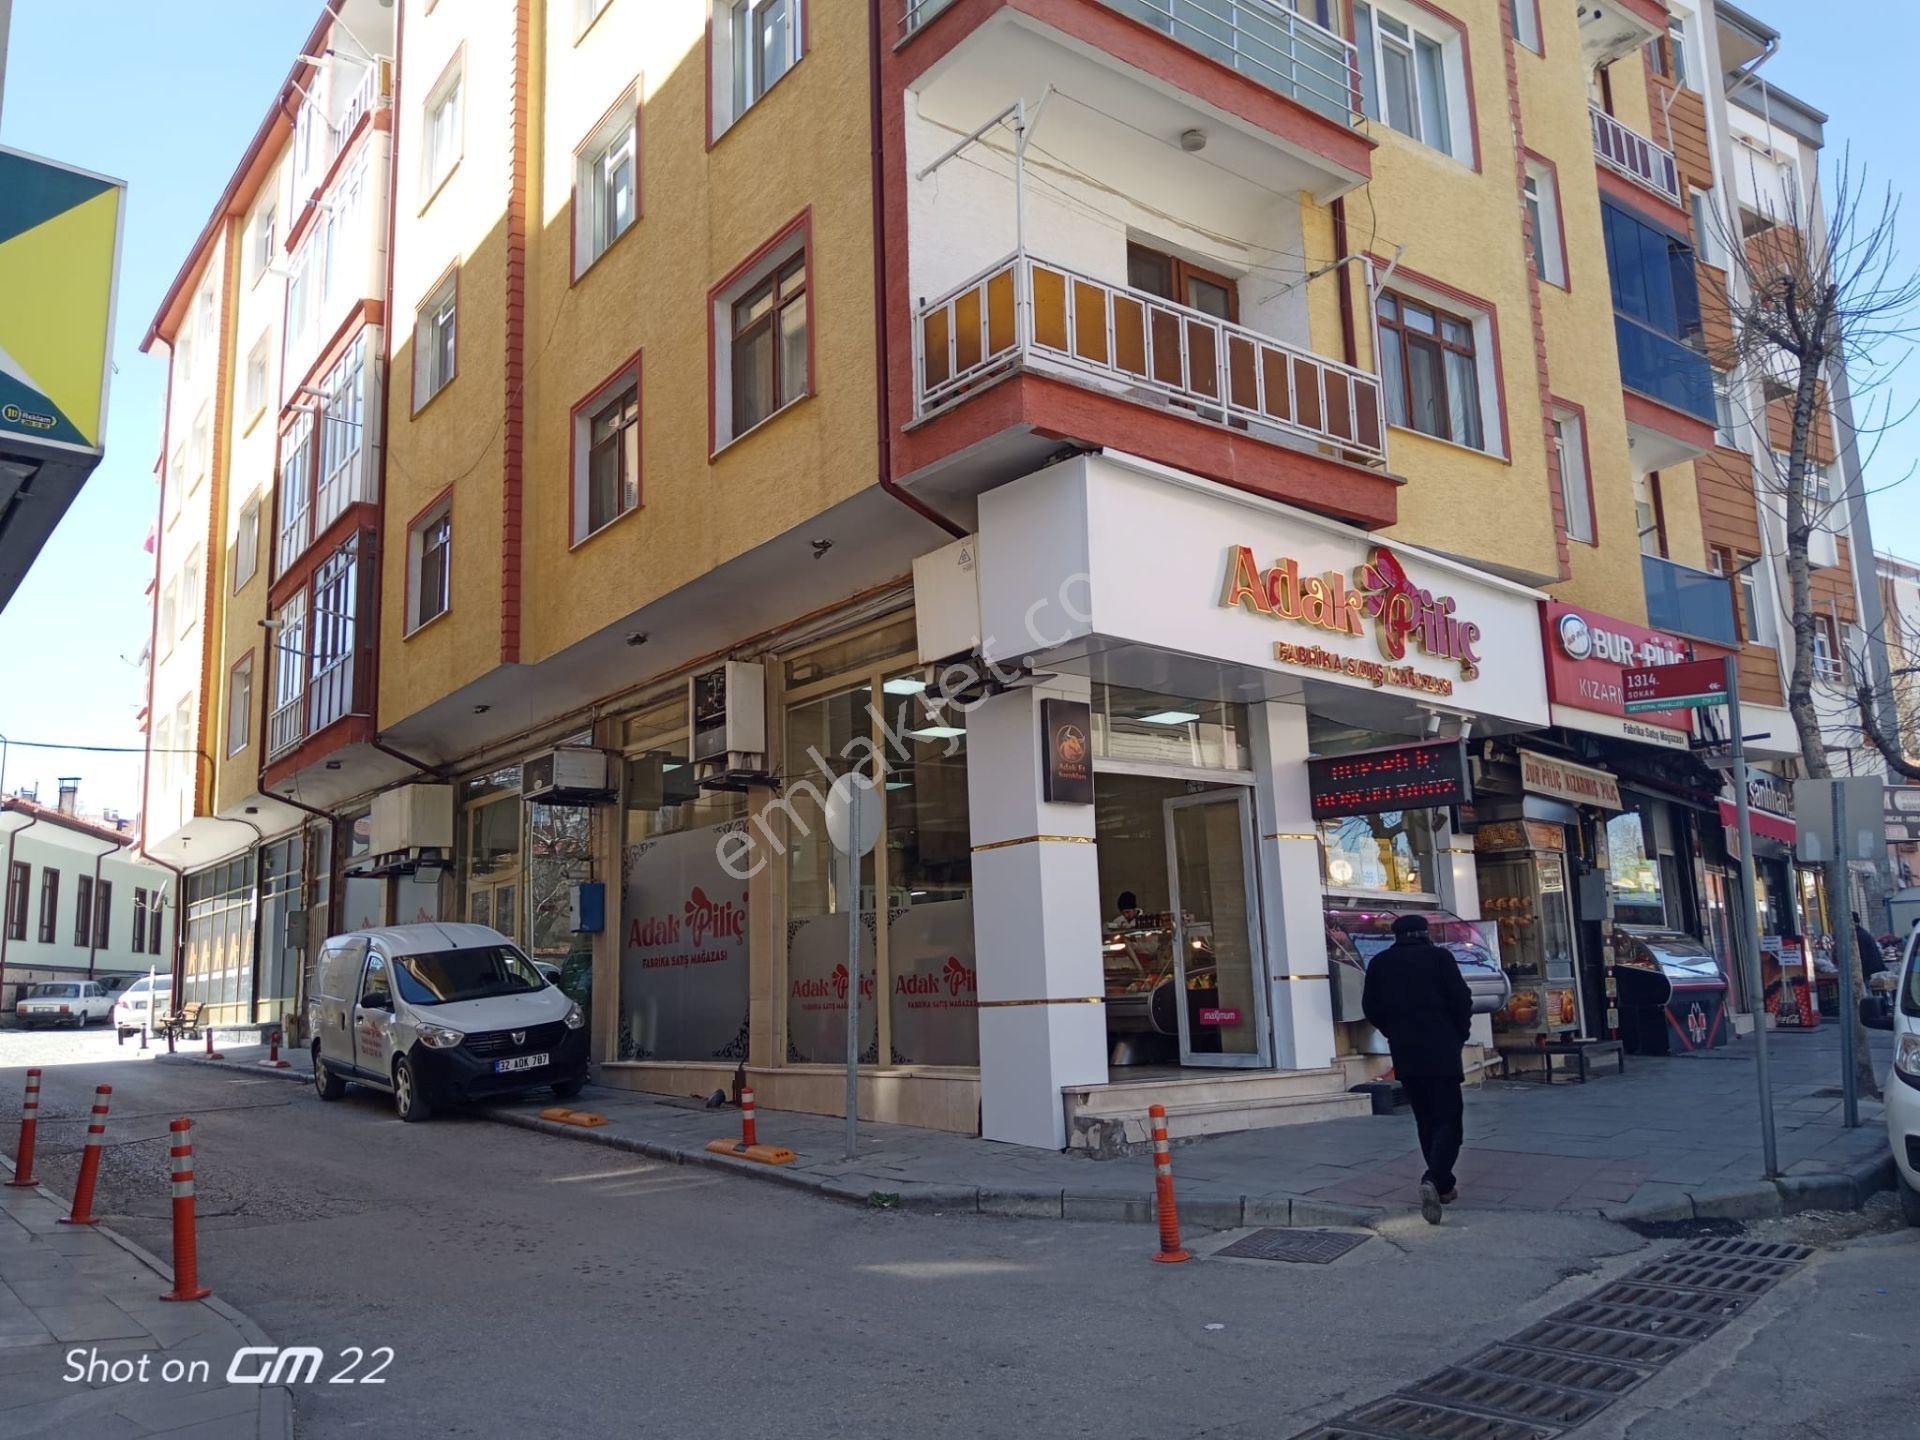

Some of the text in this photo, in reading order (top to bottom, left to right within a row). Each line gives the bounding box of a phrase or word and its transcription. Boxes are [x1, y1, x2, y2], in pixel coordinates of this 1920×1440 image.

[1220, 544, 1481, 682] Adak Piliç
[1275, 640, 1342, 673] FABRİKA
[1628, 690, 1655, 699] SOKAK
[1623, 722, 1645, 737] Fabrika
[628, 886, 746, 949] Adak Piliç
[642, 949, 727, 969] FABRİKA SATIŞ MAĞAZASI
[791, 976, 829, 998] Adak
[896, 956, 977, 996] Adak Pil
